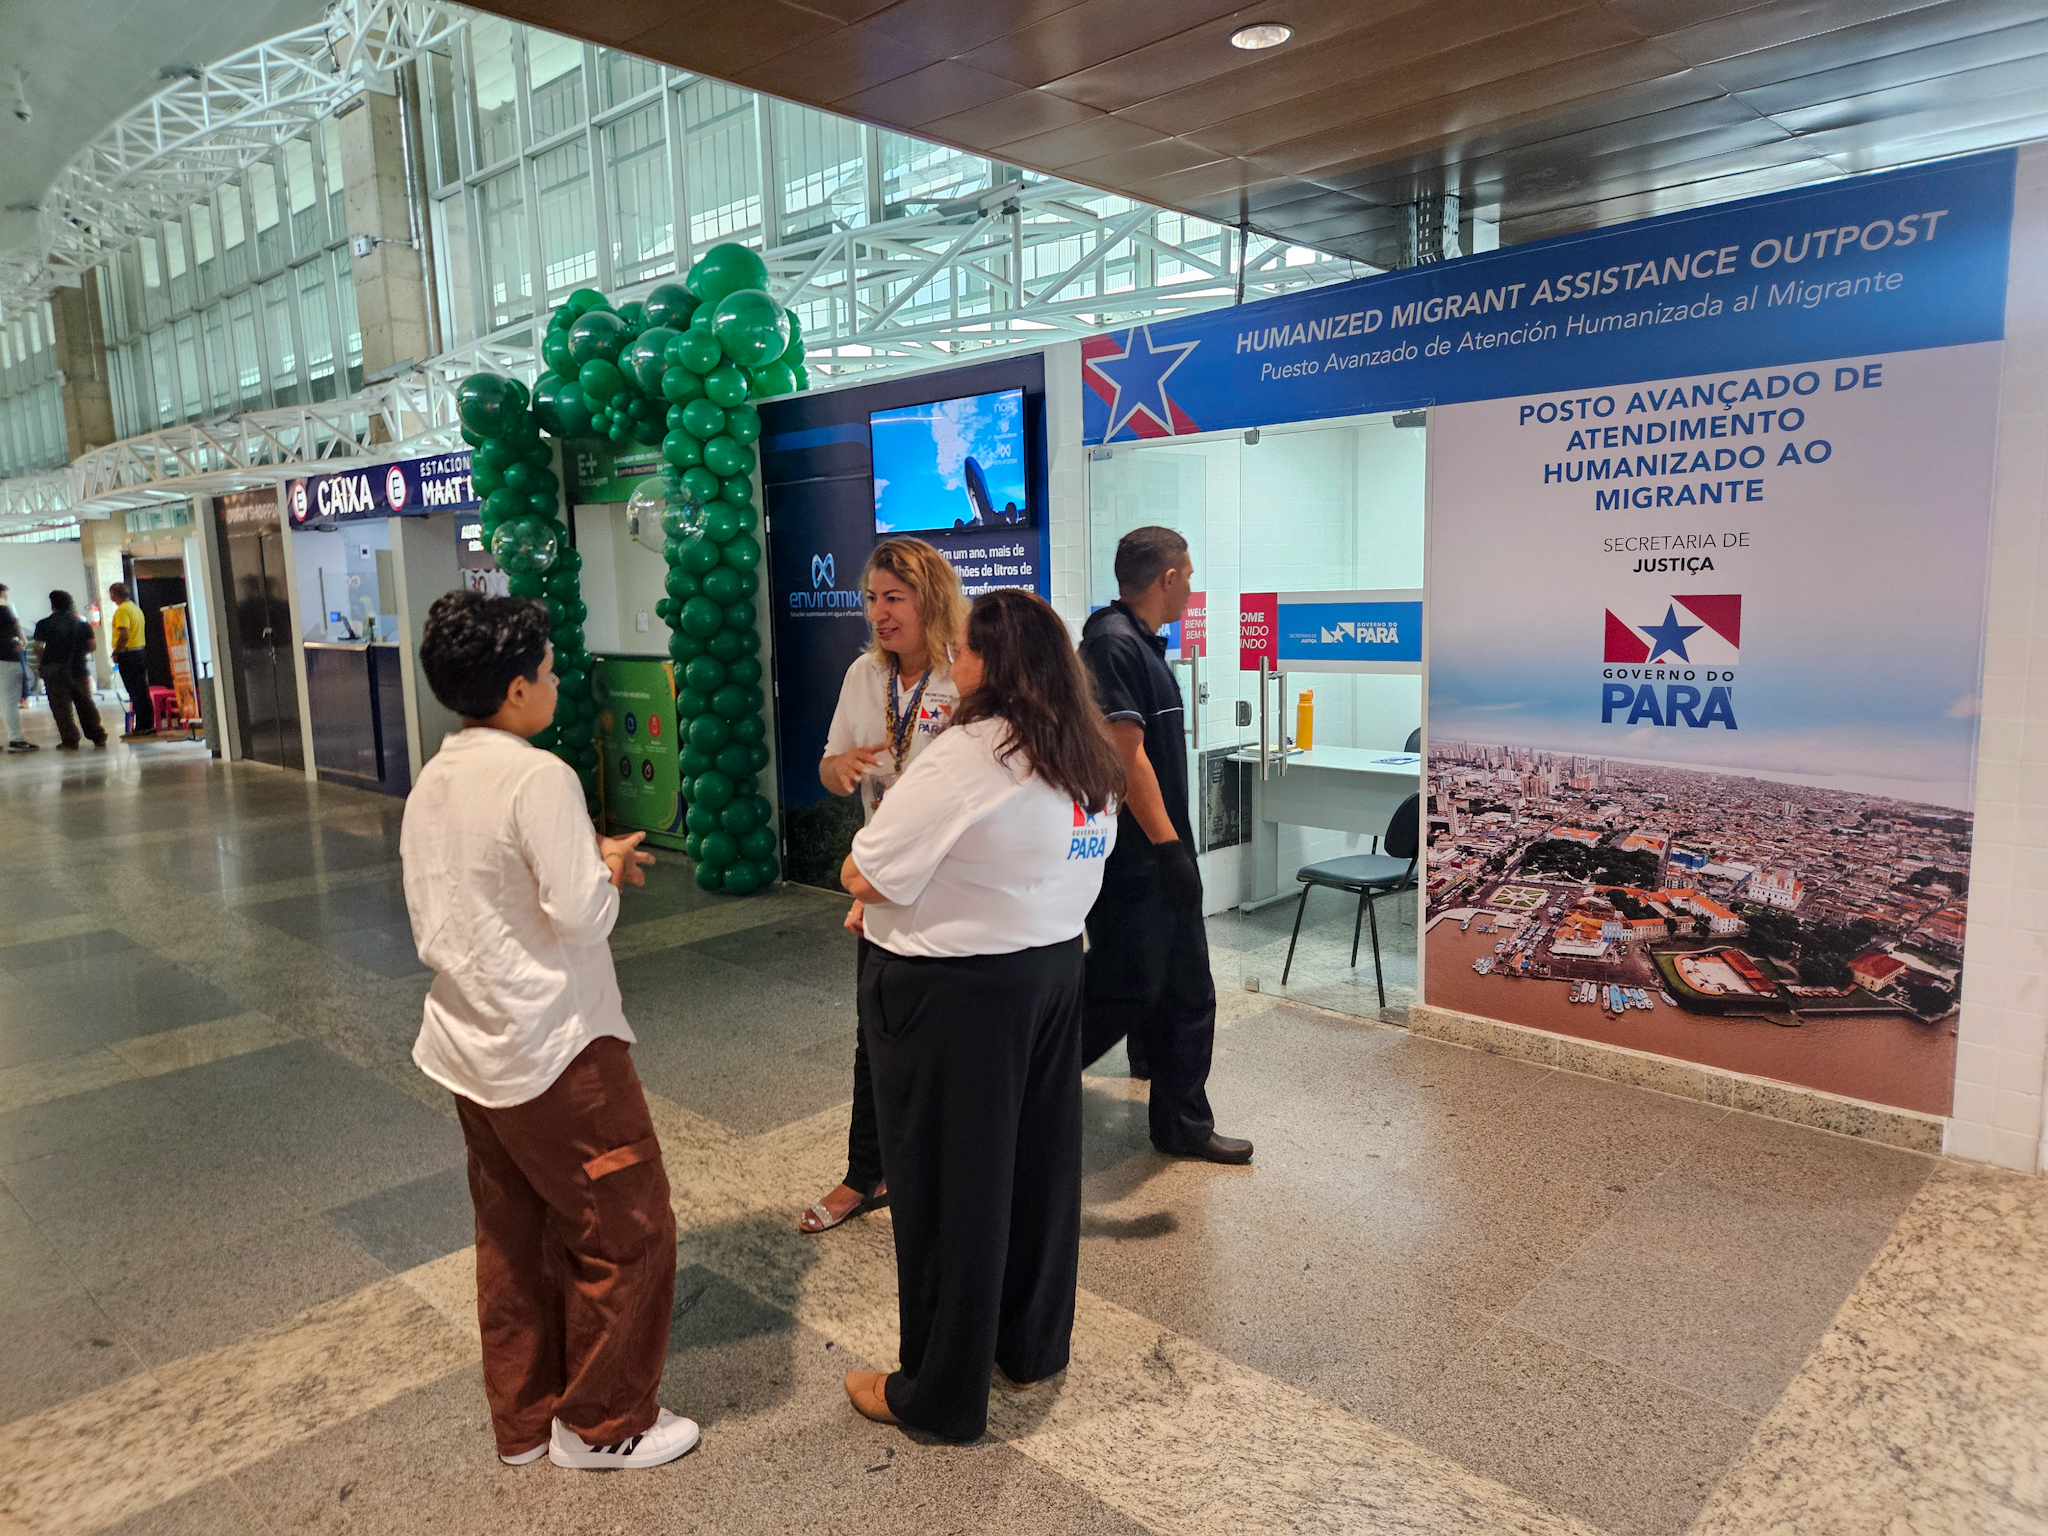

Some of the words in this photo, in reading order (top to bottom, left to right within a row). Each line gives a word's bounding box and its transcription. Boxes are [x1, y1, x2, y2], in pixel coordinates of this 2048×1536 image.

[1236, 308, 1382, 354] HUMANIZED
[1390, 283, 1525, 329] MIGRANT
[1530, 245, 1739, 307] ASSISTANCE
[1751, 210, 1948, 268] OUTPOST
[1261, 359, 1319, 381] Puesto
[1324, 341, 1417, 373] Avanzado
[1425, 336, 1451, 358] de
[1457, 321, 1557, 352] Atención
[1566, 294, 1722, 338] Humanizada
[1733, 285, 1757, 312] al
[1767, 270, 1903, 309] Migrante
[1519, 395, 1615, 426] POSTO
[1626, 371, 1820, 411] AVANÇADO
[1835, 363, 1883, 392] DE
[1566, 407, 1805, 452] ATENDIMENTO
[1544, 445, 1765, 484] HUMANIZADO
[1777, 439, 1832, 467] AO
[317, 473, 375, 516] CAIXA
[421, 476, 463, 507] MAAT
[1596, 479, 1764, 511] MIGRANTE
[953, 549, 968, 560] um
[969, 548, 988, 560] ano,
[989, 544, 1011, 558] mais
[1013, 543, 1025, 556] de
[1603, 533, 1716, 553] SECRETARIA
[1723, 532, 1750, 548] DE
[981, 563, 993, 576] de
[994, 562, 1019, 576] litros
[1020, 561, 1032, 575] de
[1633, 556, 1715, 576] JUSTIÇA
[789, 590, 862, 609] enviromix
[1603, 668, 1695, 681] GOVERNO
[1707, 671, 1735, 682] DO
